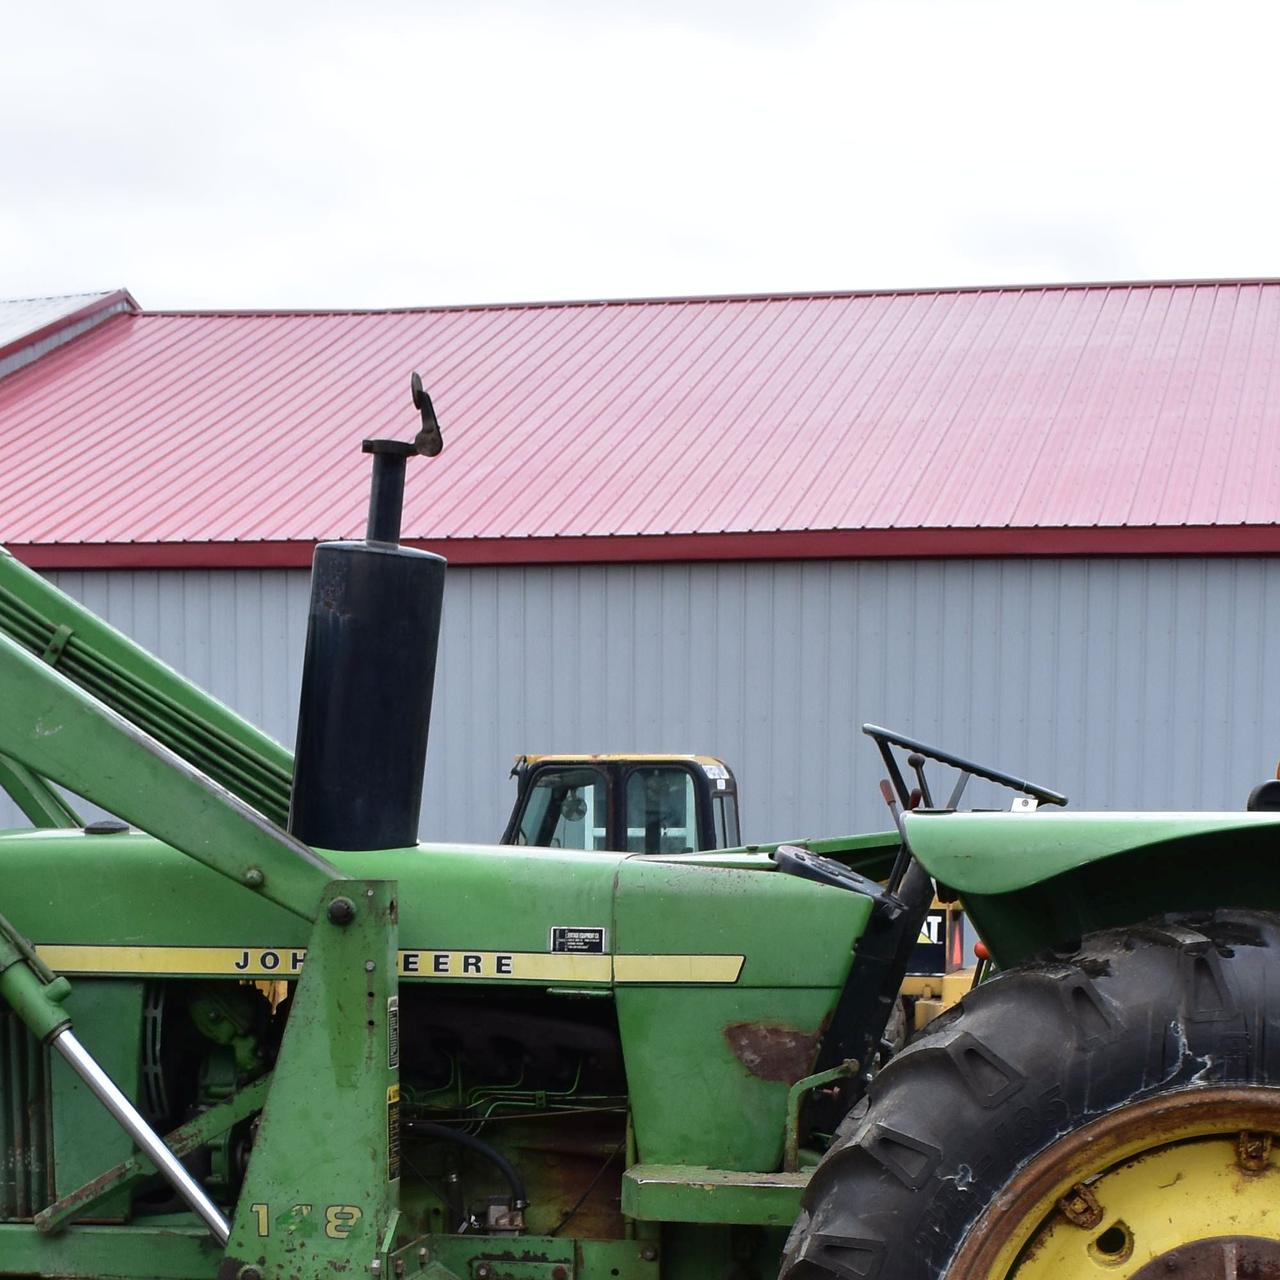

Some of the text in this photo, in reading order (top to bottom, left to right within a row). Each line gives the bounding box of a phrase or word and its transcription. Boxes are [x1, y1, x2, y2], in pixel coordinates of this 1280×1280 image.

[917, 915, 942, 944] AT
[235, 951, 513, 975] JOH EERE
